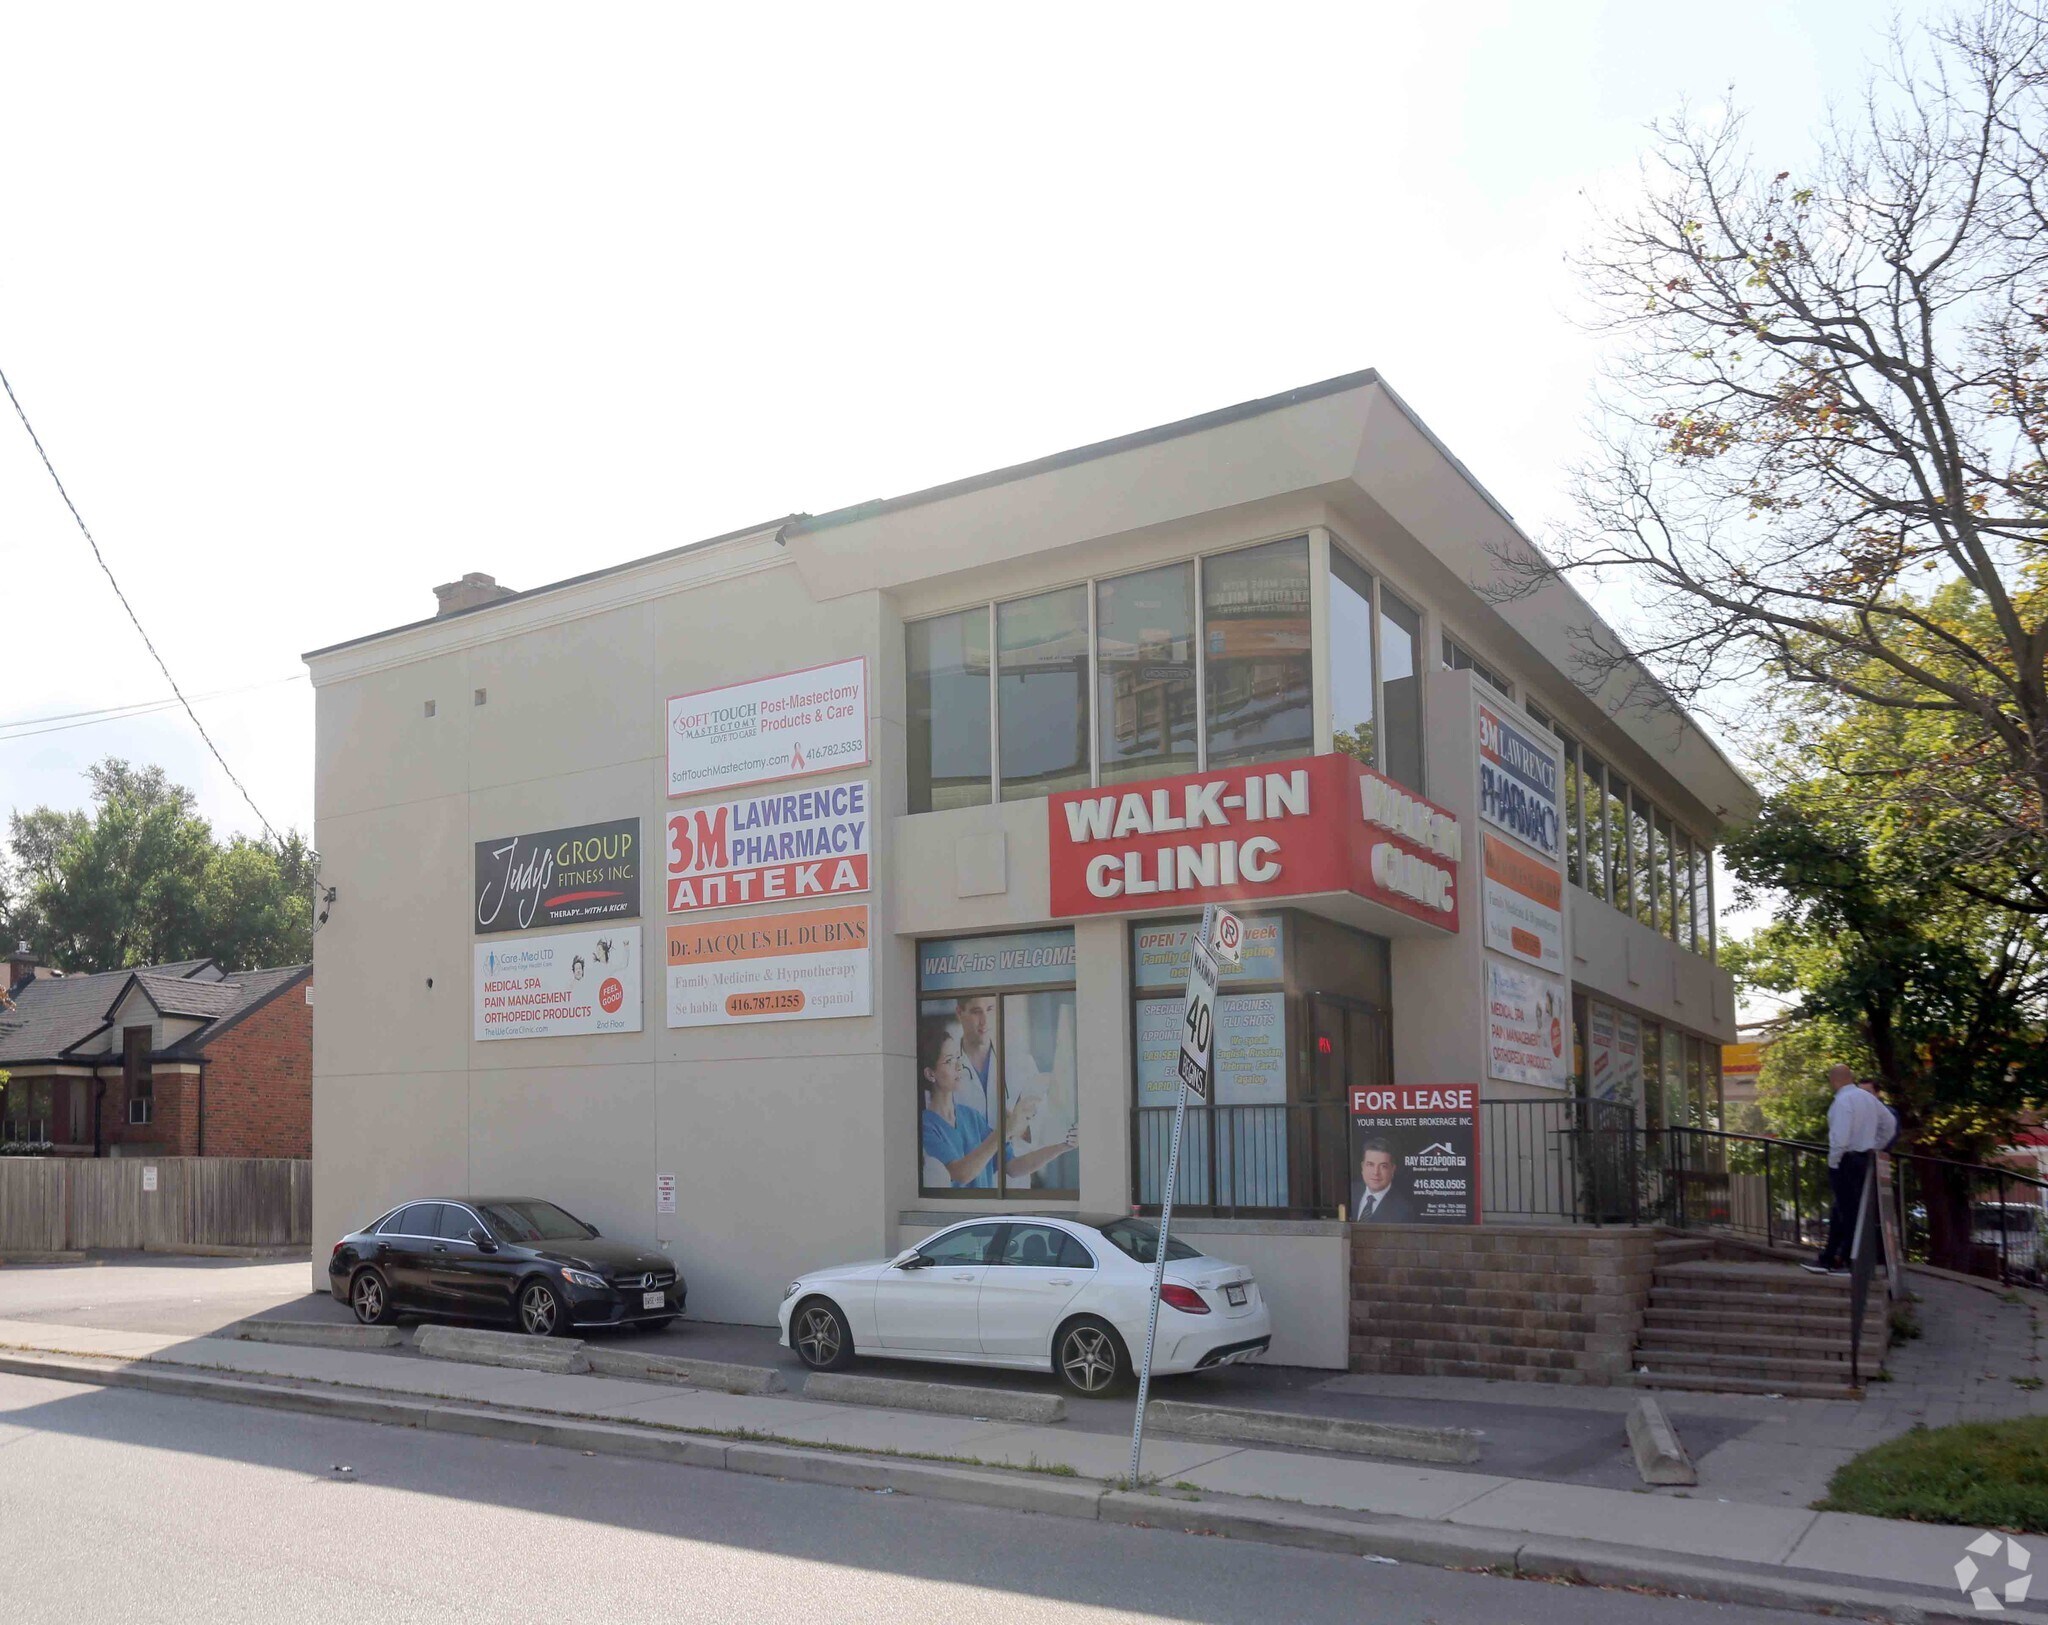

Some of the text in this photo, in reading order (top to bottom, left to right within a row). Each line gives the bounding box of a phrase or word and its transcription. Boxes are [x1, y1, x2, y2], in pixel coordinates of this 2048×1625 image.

[679, 685, 859, 731] SOFT TOUCH Post-Mastectomy
[685, 718, 757, 738] MASTECTOMY
[760, 705, 854, 733] Products & Care
[710, 728, 757, 744] LOVE TO CARE
[806, 739, 863, 760] 416.782.5353
[1480, 716, 1555, 792] 3M LAWRENCE
[672, 753, 789, 782] SoftTouchMastectomy.com
[733, 784, 864, 831] LAWRENCE
[1064, 770, 1309, 843] WALK-IN
[668, 806, 729, 873] 3M
[732, 821, 865, 866] PHARMACY
[557, 833, 633, 867] GROUP
[558, 865, 634, 887] FITNESS INC.
[1085, 836, 1282, 898] CLINIC
[478, 837, 554, 929] Judy's
[672, 859, 860, 909] АПТЕКА
[584, 906, 602, 915] WITH
[602, 905, 608, 913] A
[609, 903, 628, 912] KICK!
[671, 921, 866, 957] Dr. JACQUES H. DUBINS
[1140, 932, 1175, 948] OPEN
[1179, 932, 1188, 945] 7
[540, 950, 554, 960] LTD
[924, 954, 995, 975] WALK-ins
[1142, 950, 1179, 966] Family
[484, 978, 541, 993] MEDICAL SPA
[675, 962, 858, 990] Family Medicine & Hypnotherapy
[602, 992, 622, 1006] GOOD!
[603, 983, 618, 995] FEEL
[484, 991, 572, 1008] PAIN MANAGEMENT
[675, 1003, 687, 1015] Se
[690, 1000, 718, 1014] habla
[731, 995, 800, 1011] 416.787.1255
[484, 1006, 591, 1024] ORTHOPEDIC PRODUCTS
[1490, 1001, 1514, 1020] MEDICAL
[484, 1025, 549, 1036] TheWeCareClinic.com
[596, 1019, 625, 1029] 2nd Floor
[1186, 994, 1210, 1053] 40
[1223, 1014, 1275, 1028] FLU SHOTS
[1354, 1090, 1473, 1111] FOR LEASE
[1357, 1118, 1375, 1127] YOUR
[1377, 1118, 1393, 1126] REAL
[1395, 1118, 1417, 1126] ESTATE
[1419, 1117, 1457, 1126] BROKERAGE
[1404, 1156, 1418, 1167] RAY
[1420, 1156, 1457, 1167] REZAPOOR
